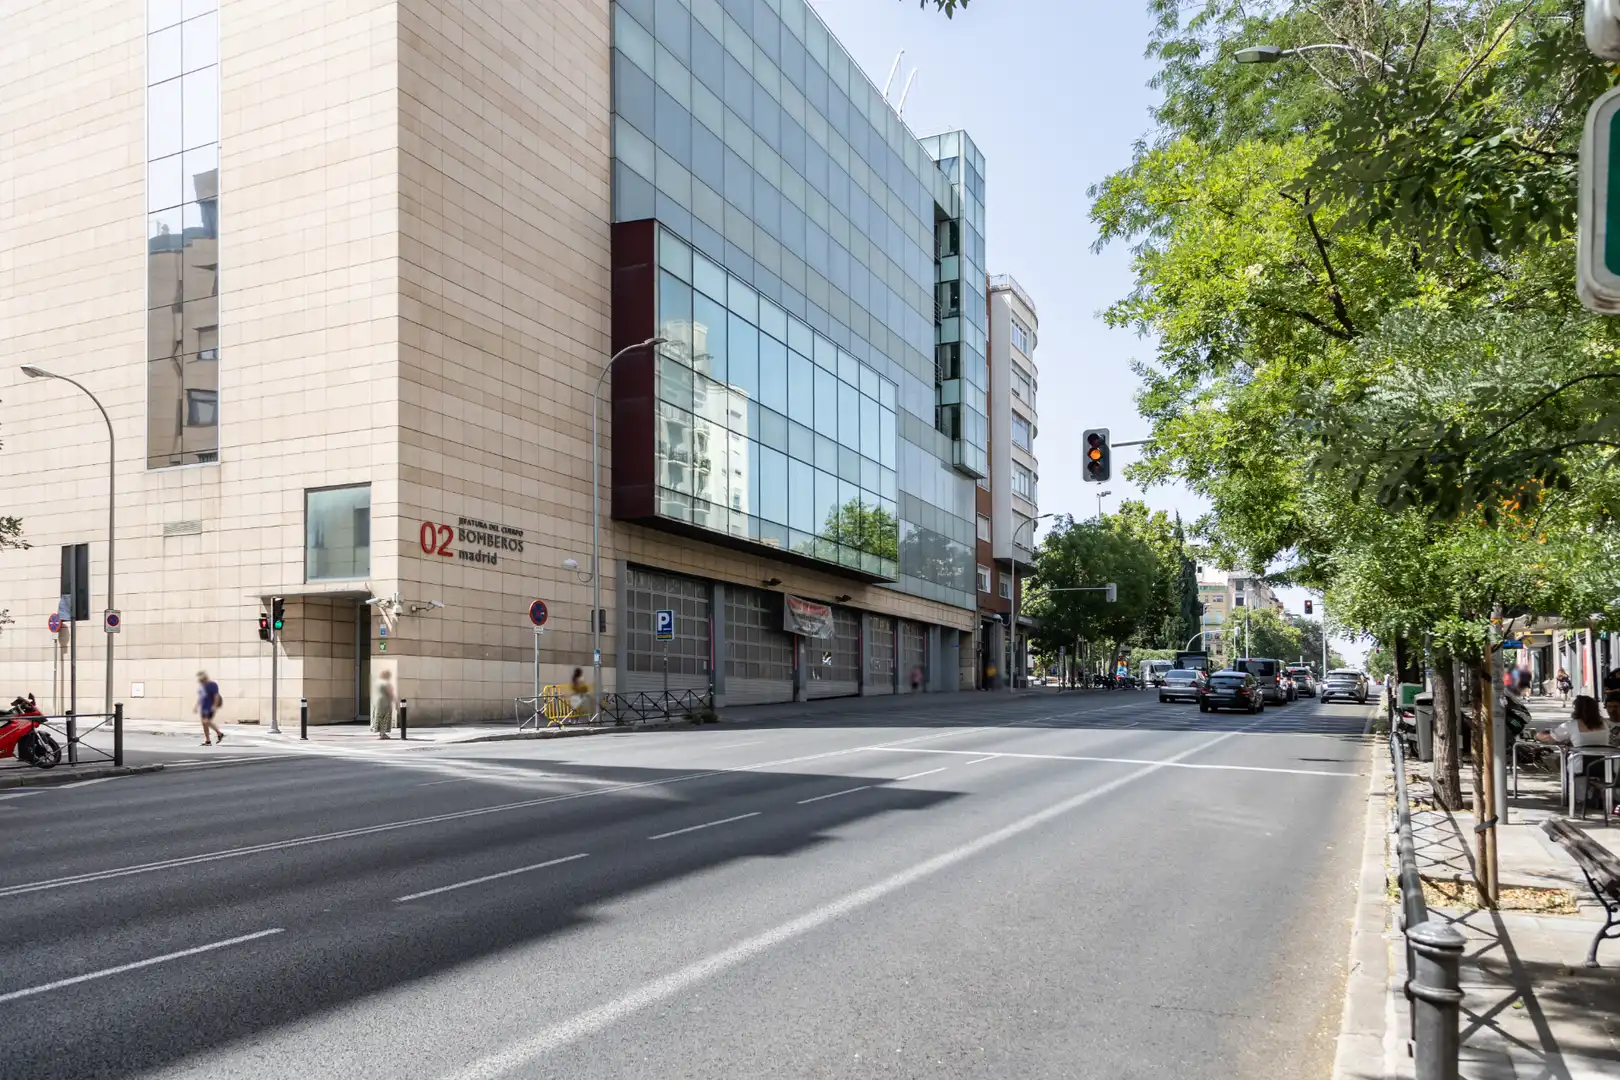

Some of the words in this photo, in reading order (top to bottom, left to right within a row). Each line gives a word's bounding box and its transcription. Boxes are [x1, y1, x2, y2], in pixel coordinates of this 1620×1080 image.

[420, 521, 454, 557] 02
[488, 523, 499, 532] DEL
[501, 526, 524, 537] CUERPO
[458, 528, 524, 552] BOMBEROS
[458, 550, 498, 565] madrid
[657, 612, 670, 631] P
